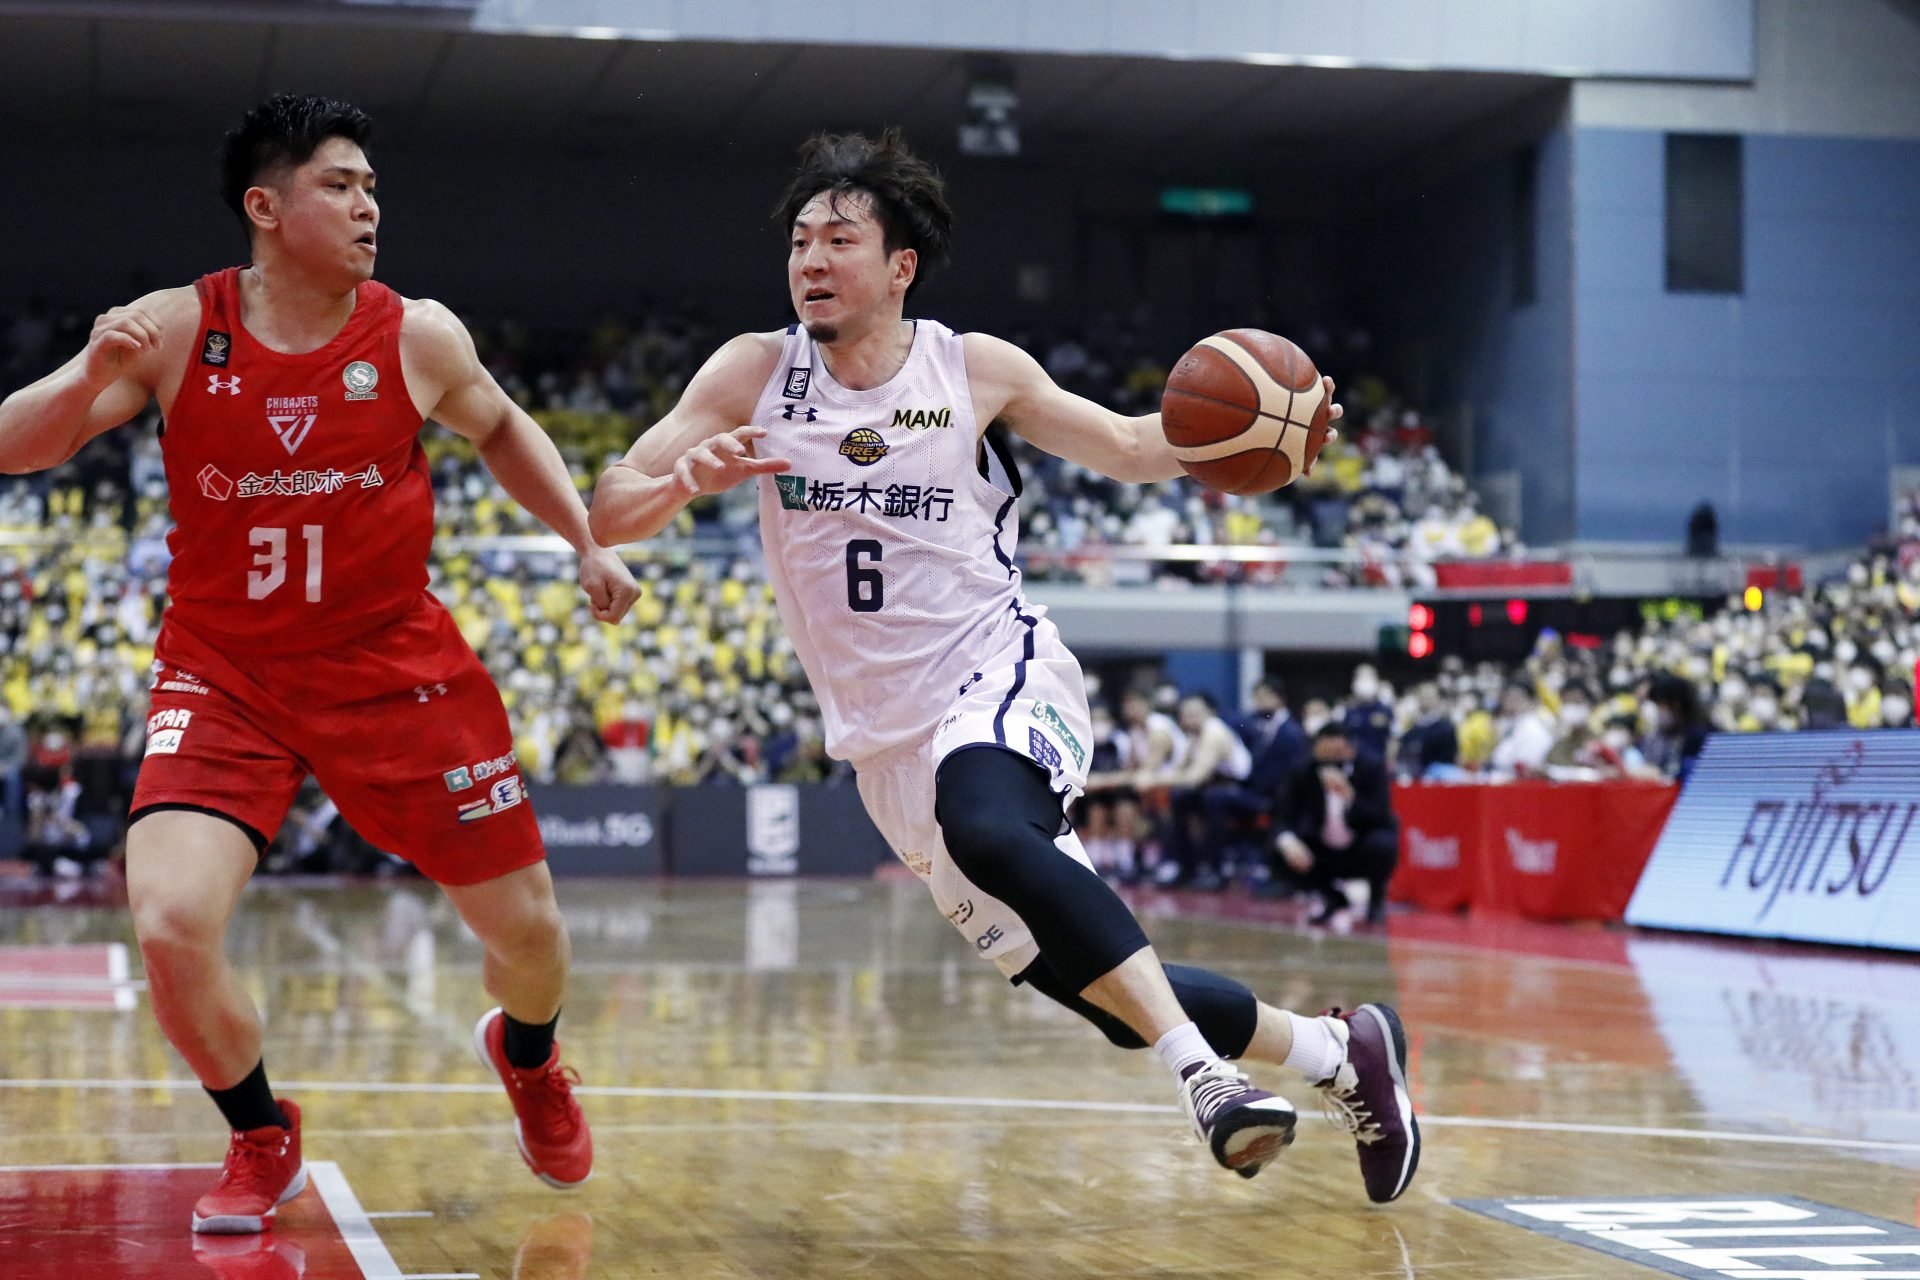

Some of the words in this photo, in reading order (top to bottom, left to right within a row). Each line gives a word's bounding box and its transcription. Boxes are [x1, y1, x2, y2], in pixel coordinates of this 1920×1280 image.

[840, 445, 889, 456] BREX
[237, 464, 384, 498] 金太郎ホーム
[807, 479, 954, 522] 栃木銀行
[247, 524, 324, 603] 31
[845, 539, 884, 613] 6
[1718, 801, 1919, 925] FUJITSU
